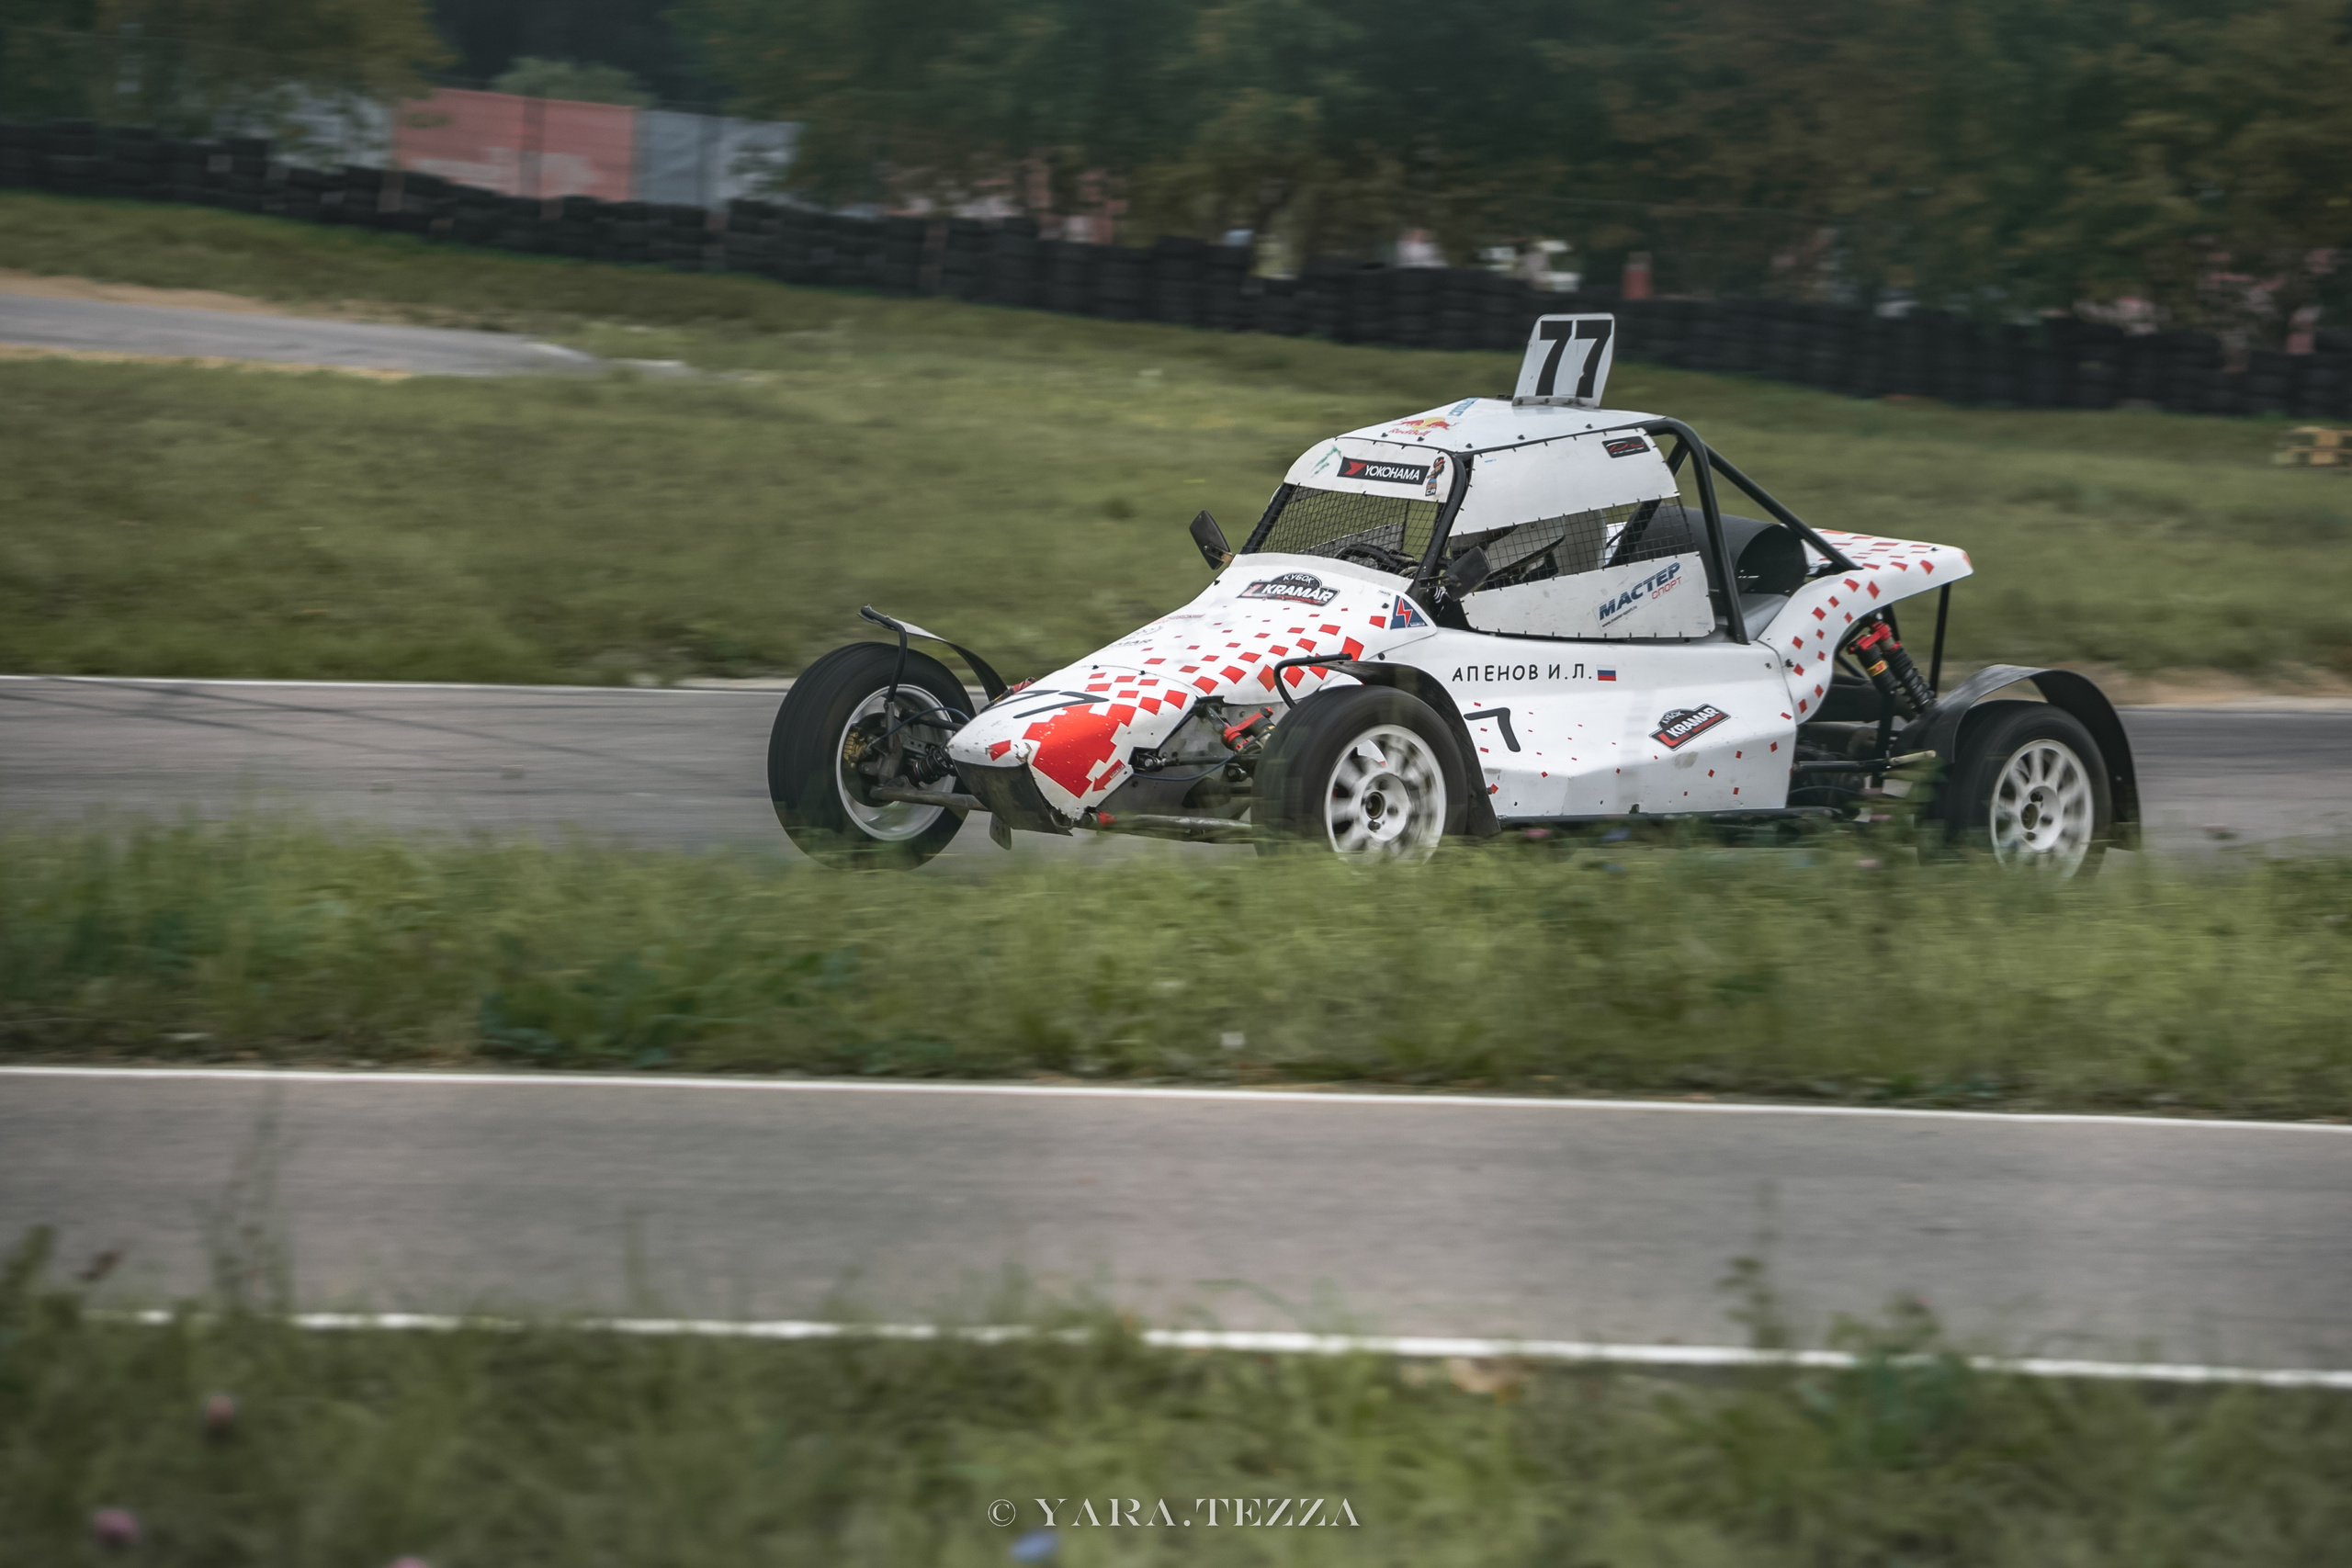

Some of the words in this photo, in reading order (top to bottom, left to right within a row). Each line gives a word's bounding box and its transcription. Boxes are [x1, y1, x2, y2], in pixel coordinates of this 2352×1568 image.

[1535, 320, 1612, 398] 77
[1364, 464, 1420, 480] YOKOHAMA
[1261, 584, 1334, 602] KRAMAR
[1599, 561, 1681, 621] МАСТЕР
[1651, 576, 1682, 600] СПОРТ
[1452, 664, 1539, 682] АПЕНОВ
[1548, 663, 1592, 681] И.Л.
[1666, 707, 1720, 738] KRAMAR
